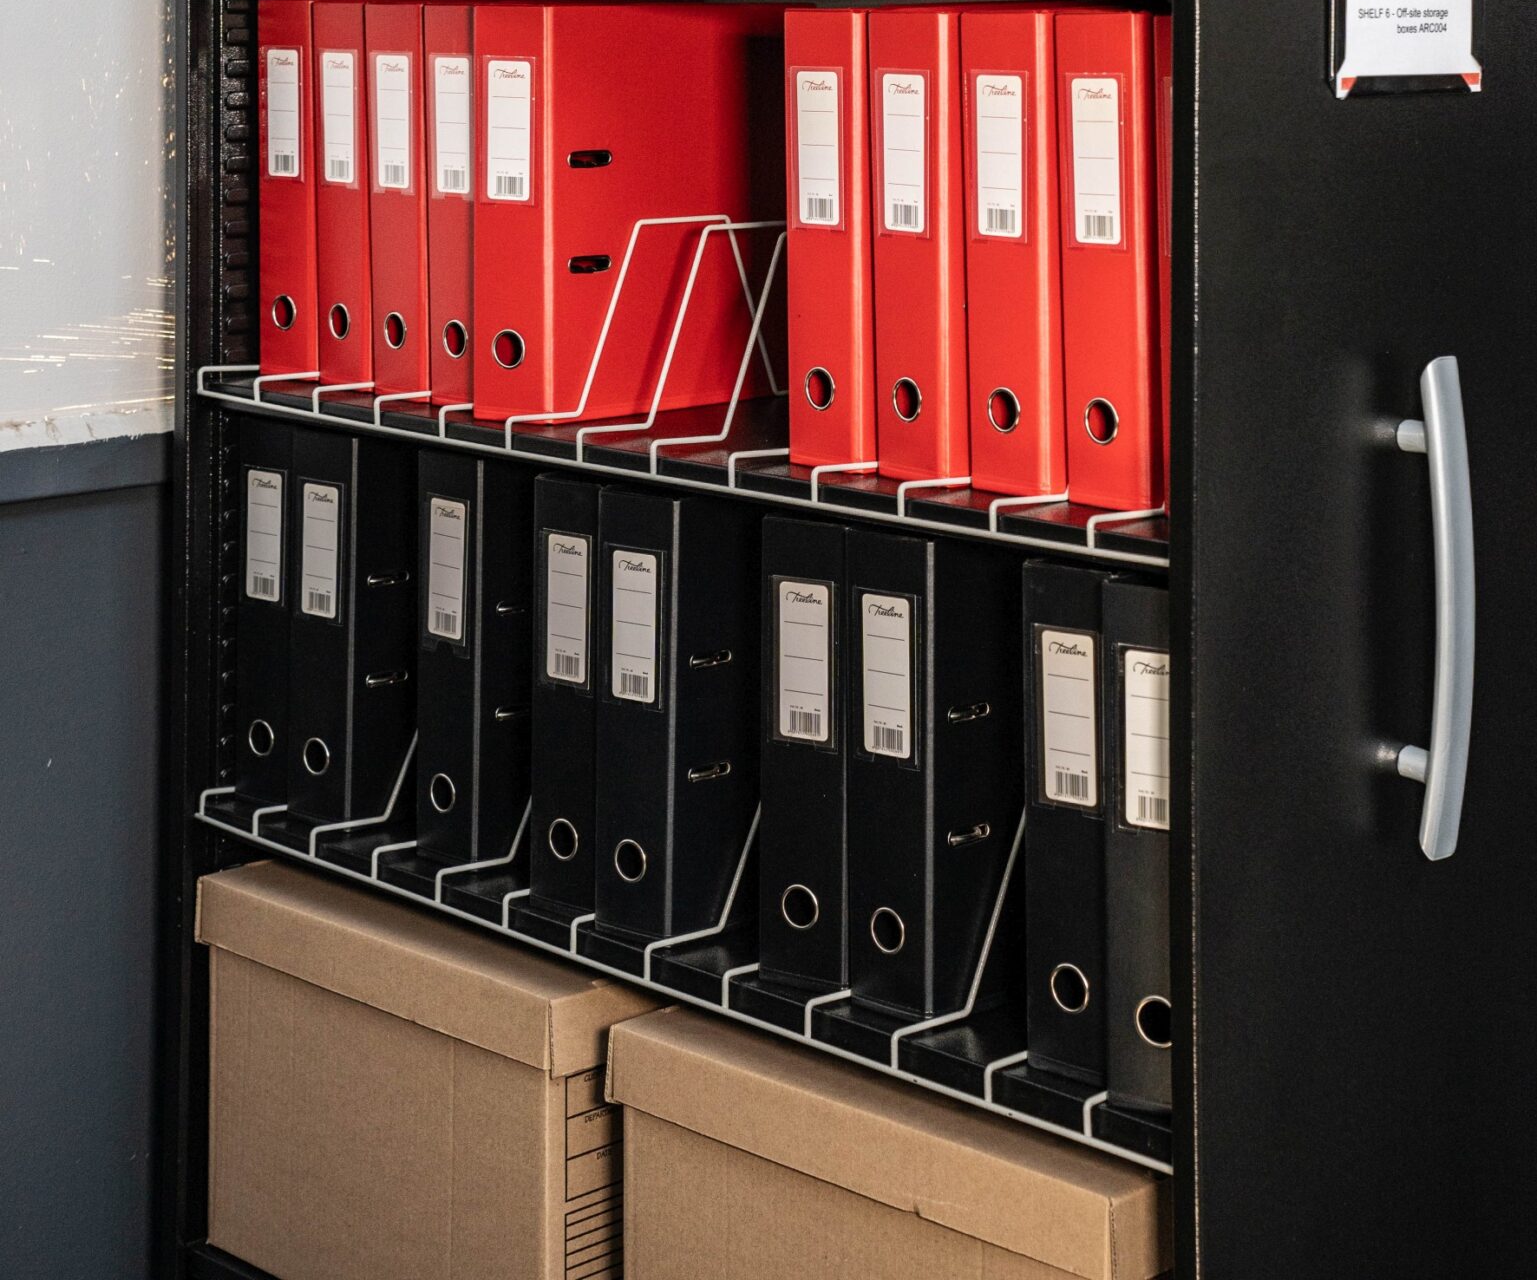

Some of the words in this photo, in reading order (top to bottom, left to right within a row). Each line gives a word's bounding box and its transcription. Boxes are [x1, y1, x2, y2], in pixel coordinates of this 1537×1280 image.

[1358, 7, 1383, 18] SHELF
[1396, 8, 1421, 18] Off-site
[1422, 8, 1449, 19] storage
[1396, 23, 1417, 34] boxes
[1418, 23, 1447, 33] ARC004
[493, 68, 526, 80] Treeline
[801, 79, 833, 92] Treeline
[887, 82, 920, 96] Treeline
[981, 84, 1017, 97] Treeline
[1077, 87, 1112, 101] Treeline
[250, 476, 278, 490] Treeline
[307, 491, 334, 504] Treeline
[434, 505, 462, 521] Treeline
[552, 542, 584, 557] Treeline
[617, 559, 652, 574] Treeline
[785, 590, 823, 606] Treeline
[867, 603, 905, 619] Treeline
[1048, 640, 1088, 658] Treeline
[1132, 661, 1169, 676] Treelin
